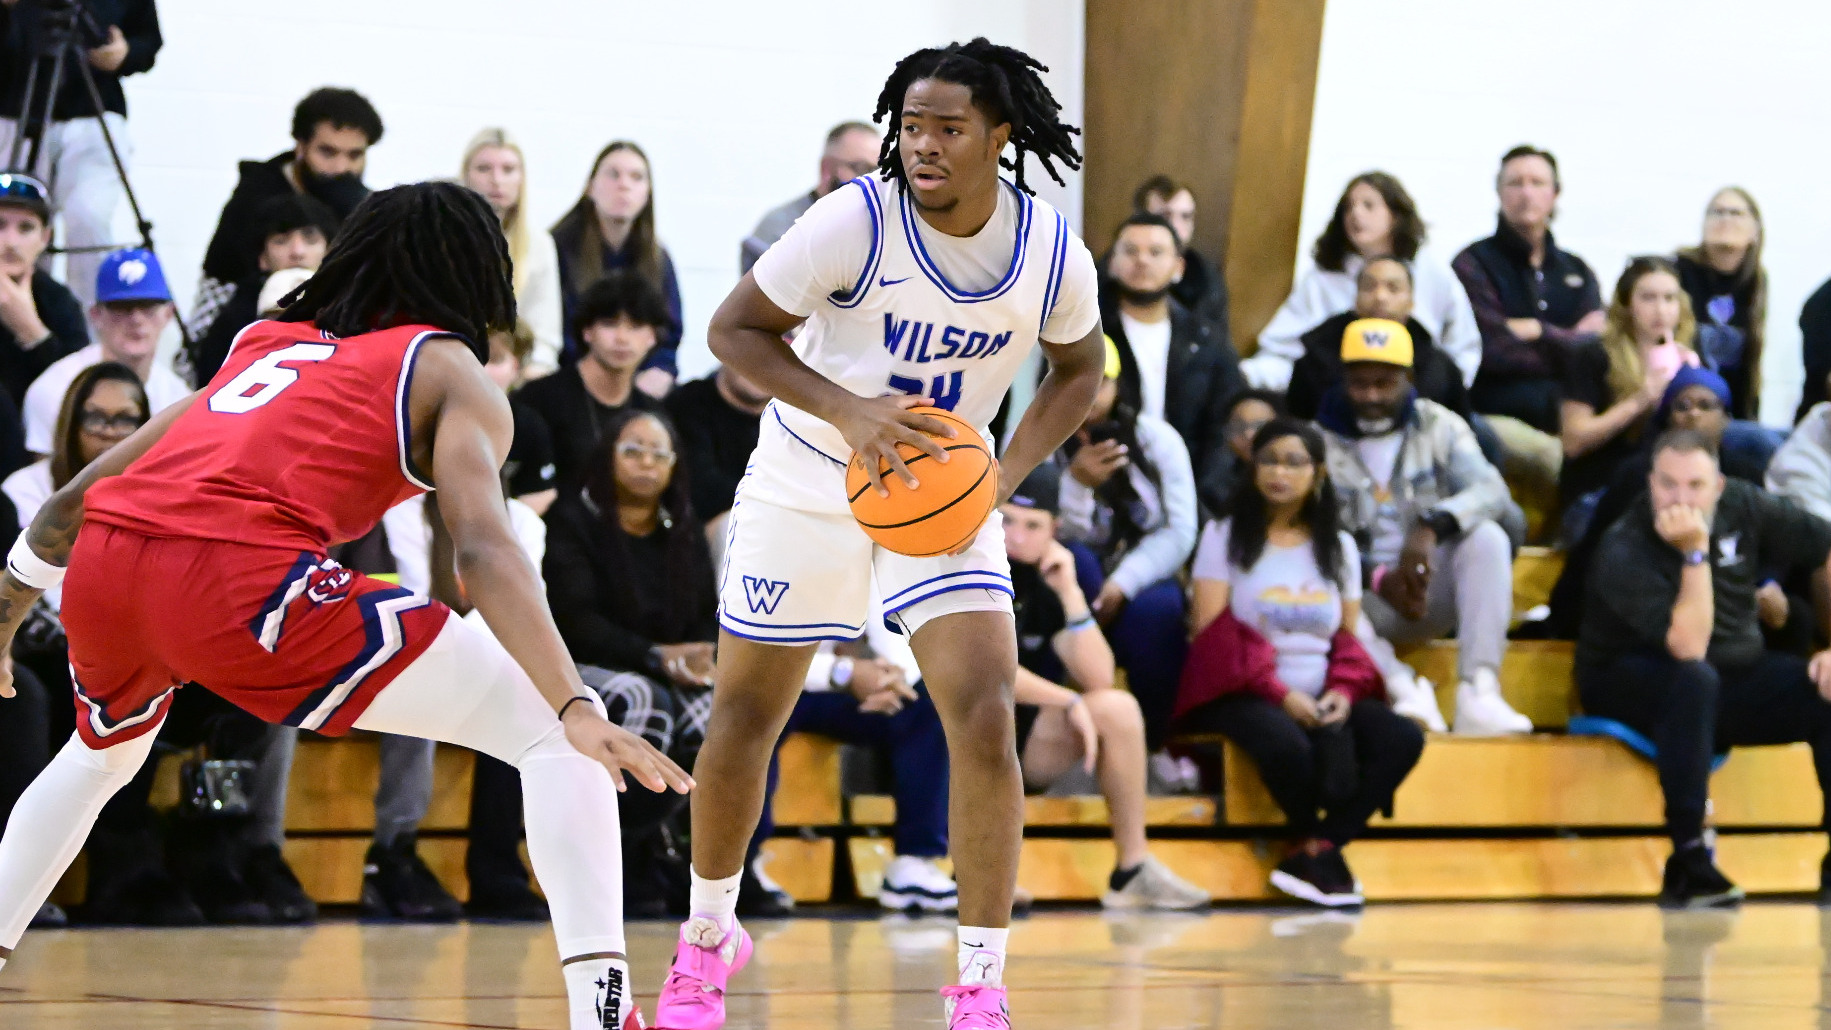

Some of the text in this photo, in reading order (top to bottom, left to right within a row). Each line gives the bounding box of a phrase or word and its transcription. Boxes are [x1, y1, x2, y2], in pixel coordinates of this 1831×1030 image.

[884, 312, 1013, 363] WILSON
[1362, 331, 1388, 347] W
[208, 341, 338, 414] 6
[742, 575, 789, 615] W
